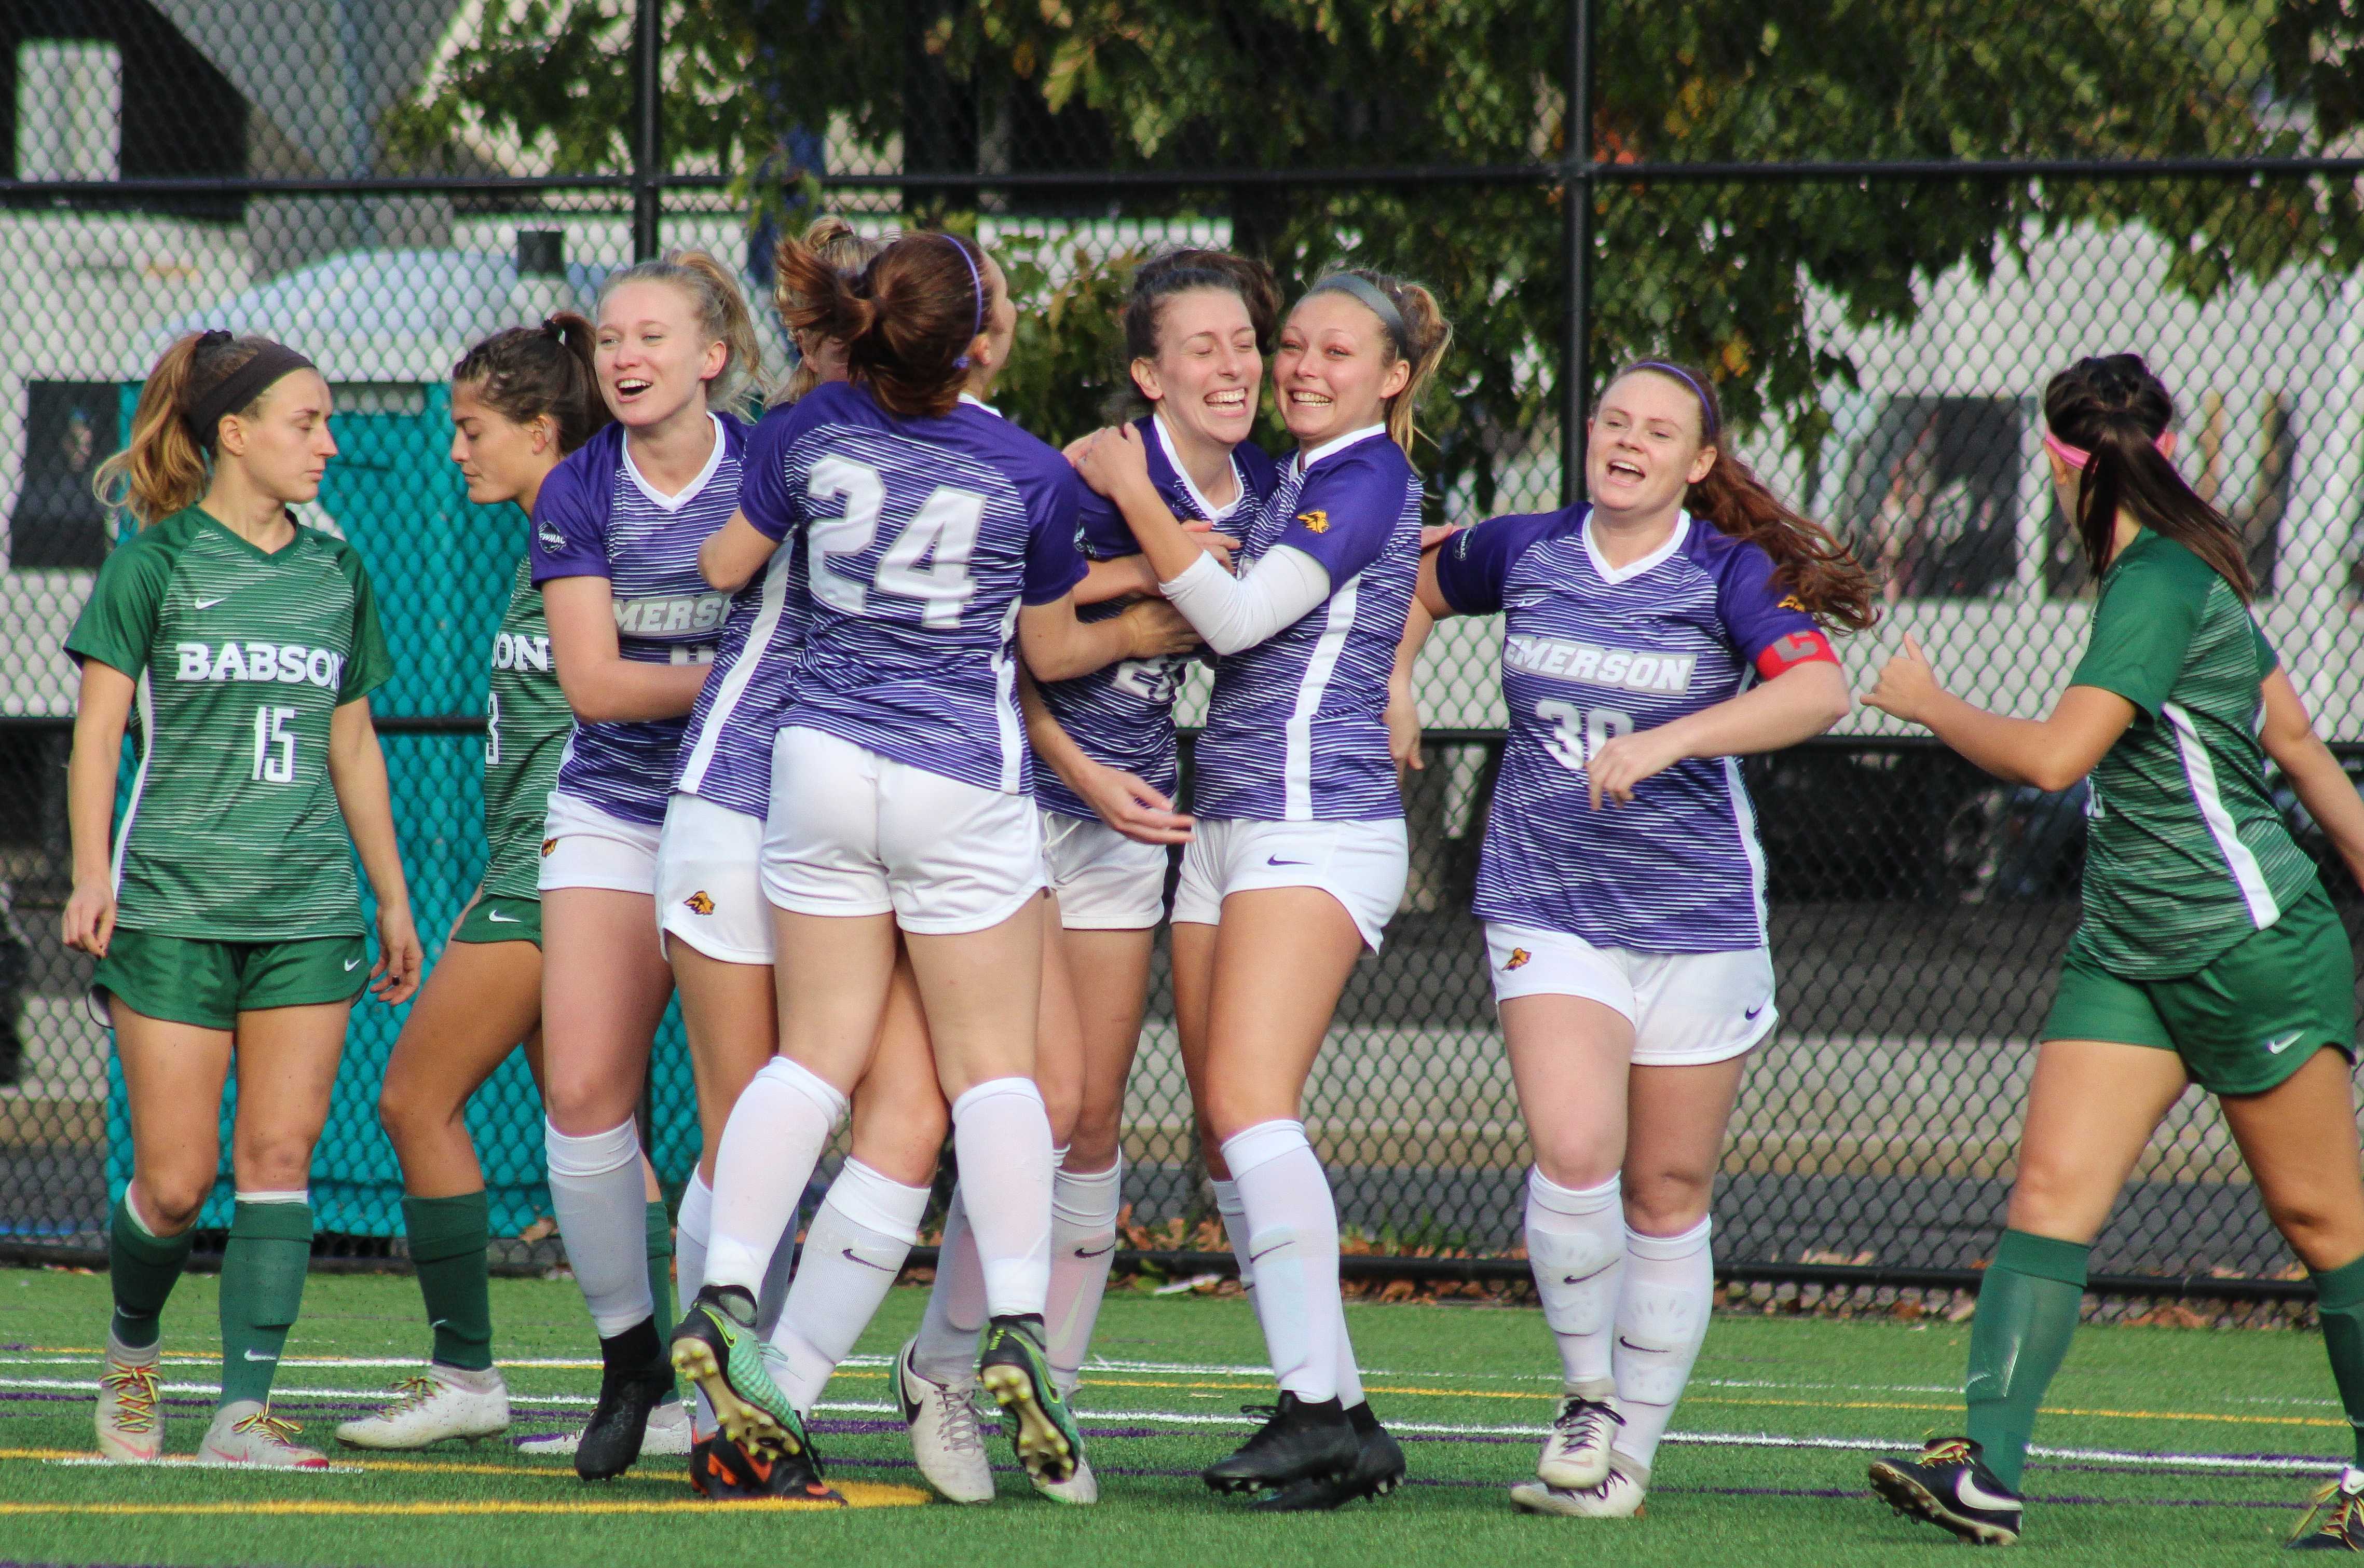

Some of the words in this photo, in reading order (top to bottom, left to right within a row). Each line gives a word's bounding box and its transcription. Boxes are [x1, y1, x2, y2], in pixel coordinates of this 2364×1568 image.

[808, 454, 989, 629] 24
[491, 633, 550, 672] ON
[1505, 634, 1693, 692] EMERSON
[251, 706, 295, 783] 15
[1535, 699, 1635, 770] 30
